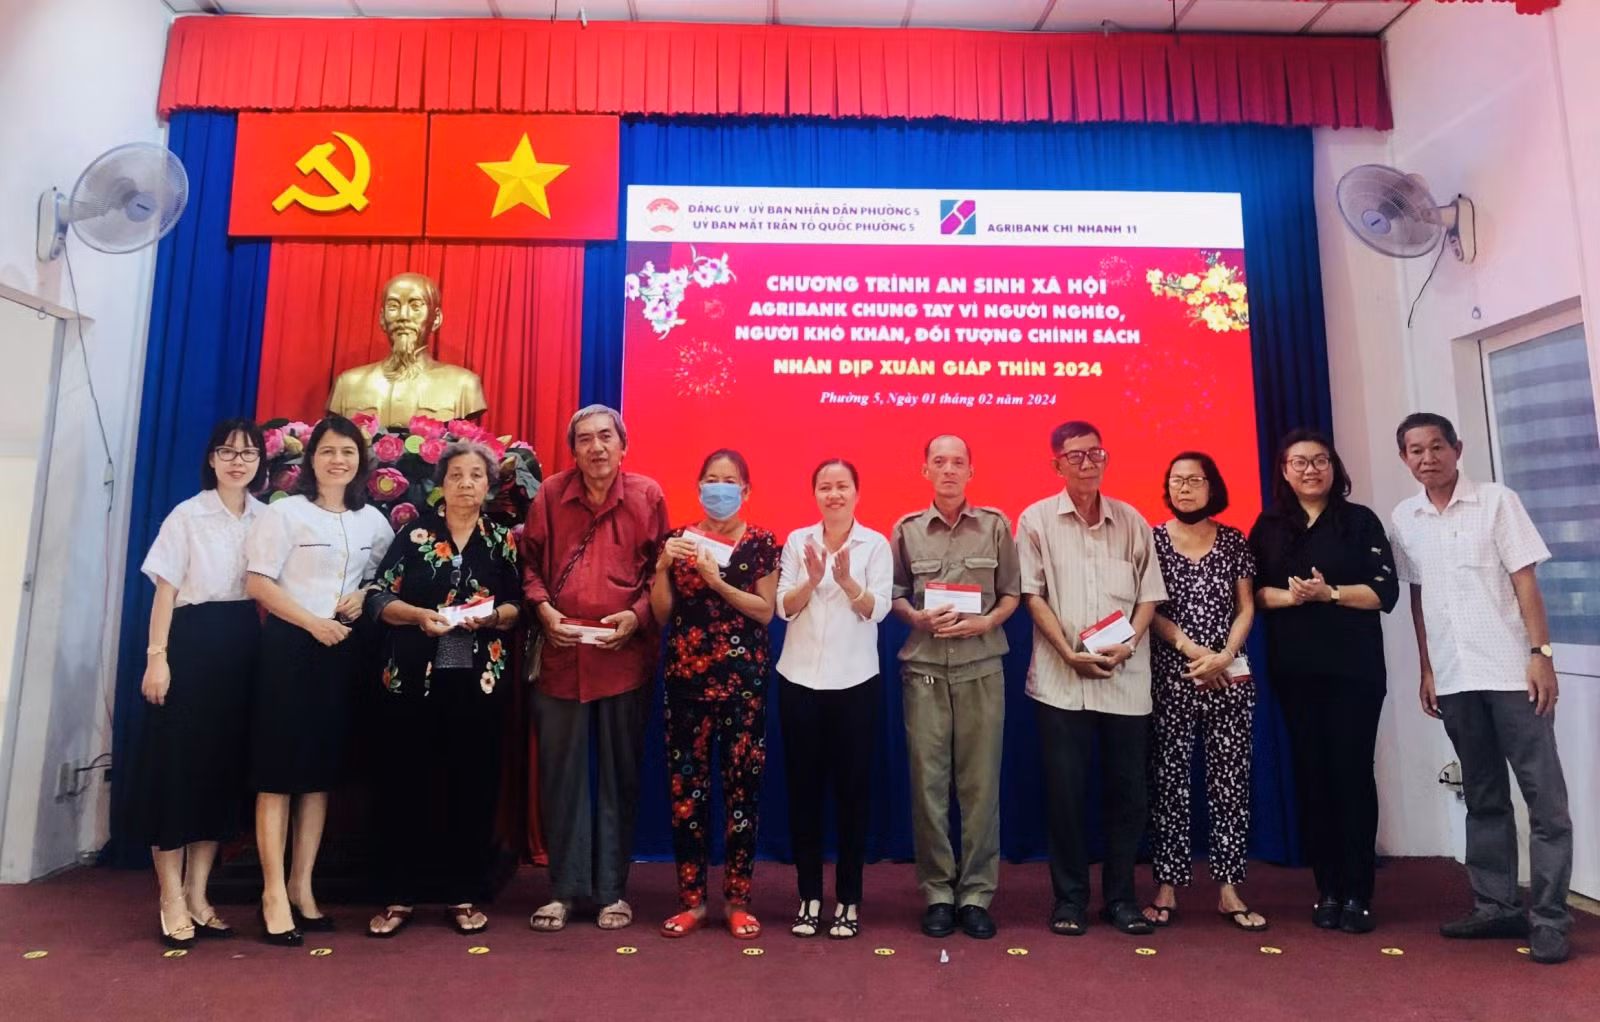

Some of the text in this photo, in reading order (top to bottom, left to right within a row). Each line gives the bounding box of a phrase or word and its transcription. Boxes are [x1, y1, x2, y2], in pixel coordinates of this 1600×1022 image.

[767, 206, 792, 215] BAN
[795, 203, 829, 216] NHÂN
[833, 203, 857, 216] DÂN
[914, 208, 920, 217] 5
[712, 221, 736, 230] BAN
[909, 223, 915, 232] 5
[987, 224, 1137, 234] AGRIBANK CHI NHANH 11
[766, 274, 1107, 299] CHƯƠNG TRÌNH AN SINH XÃ HỘI
[749, 301, 1126, 323] AGRIBANK CHUNG TAY VÌ NGƯỜI NGHÈO,
[735, 324, 799, 341] NGƯỜI
[804, 324, 845, 341] KHÓ
[914, 324, 950, 342] ĐỐI
[955, 328, 1022, 346] TƯỢNG
[1027, 326, 1088, 344] CHÍNH
[1093, 327, 1141, 344] SÁCH
[773, 356, 1103, 379] NHÂN DỊP XUÂN GIÁP THÌN 2024
[820, 391, 1057, 407] Phường 5, Ngày 01 tháng 02 năm 2024
